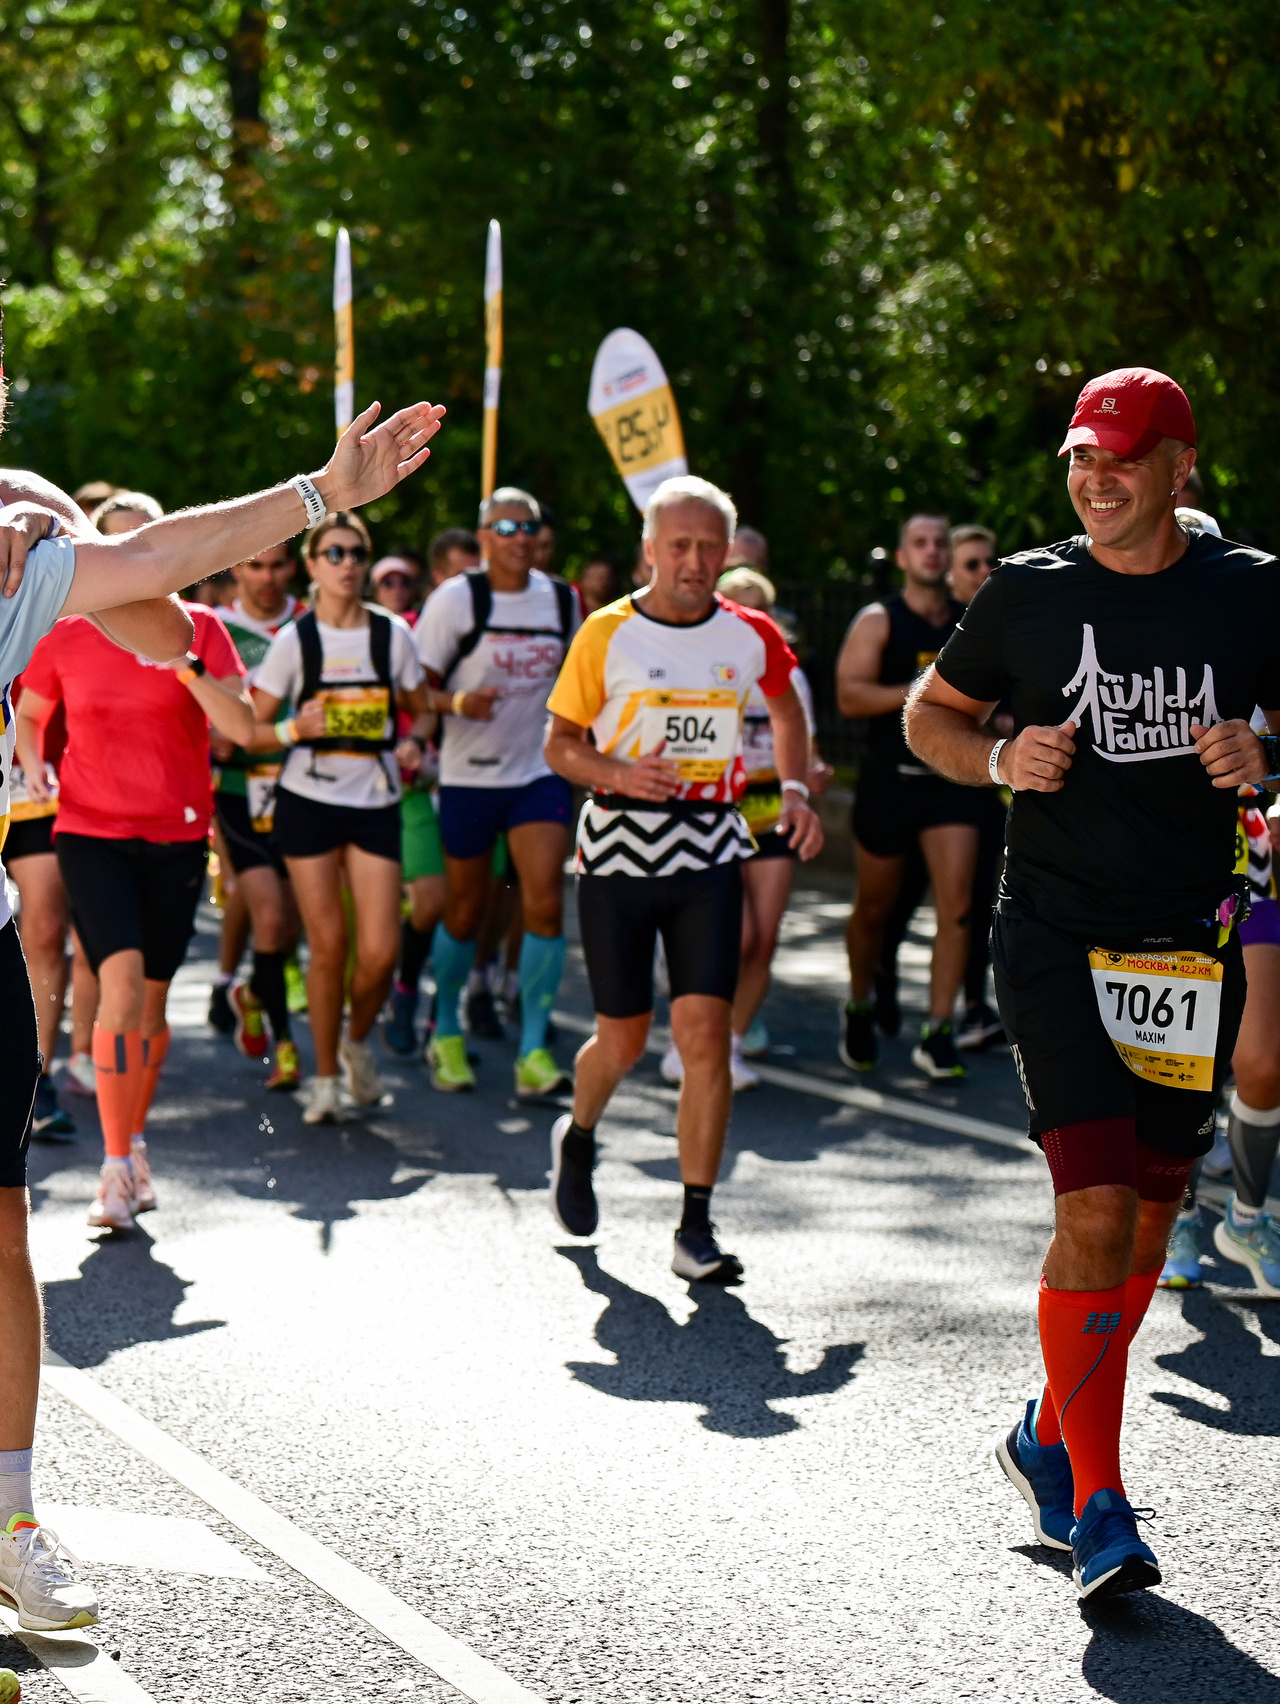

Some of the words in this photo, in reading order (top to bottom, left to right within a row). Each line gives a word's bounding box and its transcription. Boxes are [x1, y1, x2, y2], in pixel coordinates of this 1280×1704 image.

[665, 716, 717, 743] 504
[990, 746, 1000, 769] 7061
[1127, 959, 1170, 972] МОСКВА
[1179, 966, 1197, 975] 42,2
[1198, 968, 1212, 976] КМ
[1106, 981, 1198, 1031] 7061
[1135, 1030, 1166, 1045] MAXIM
